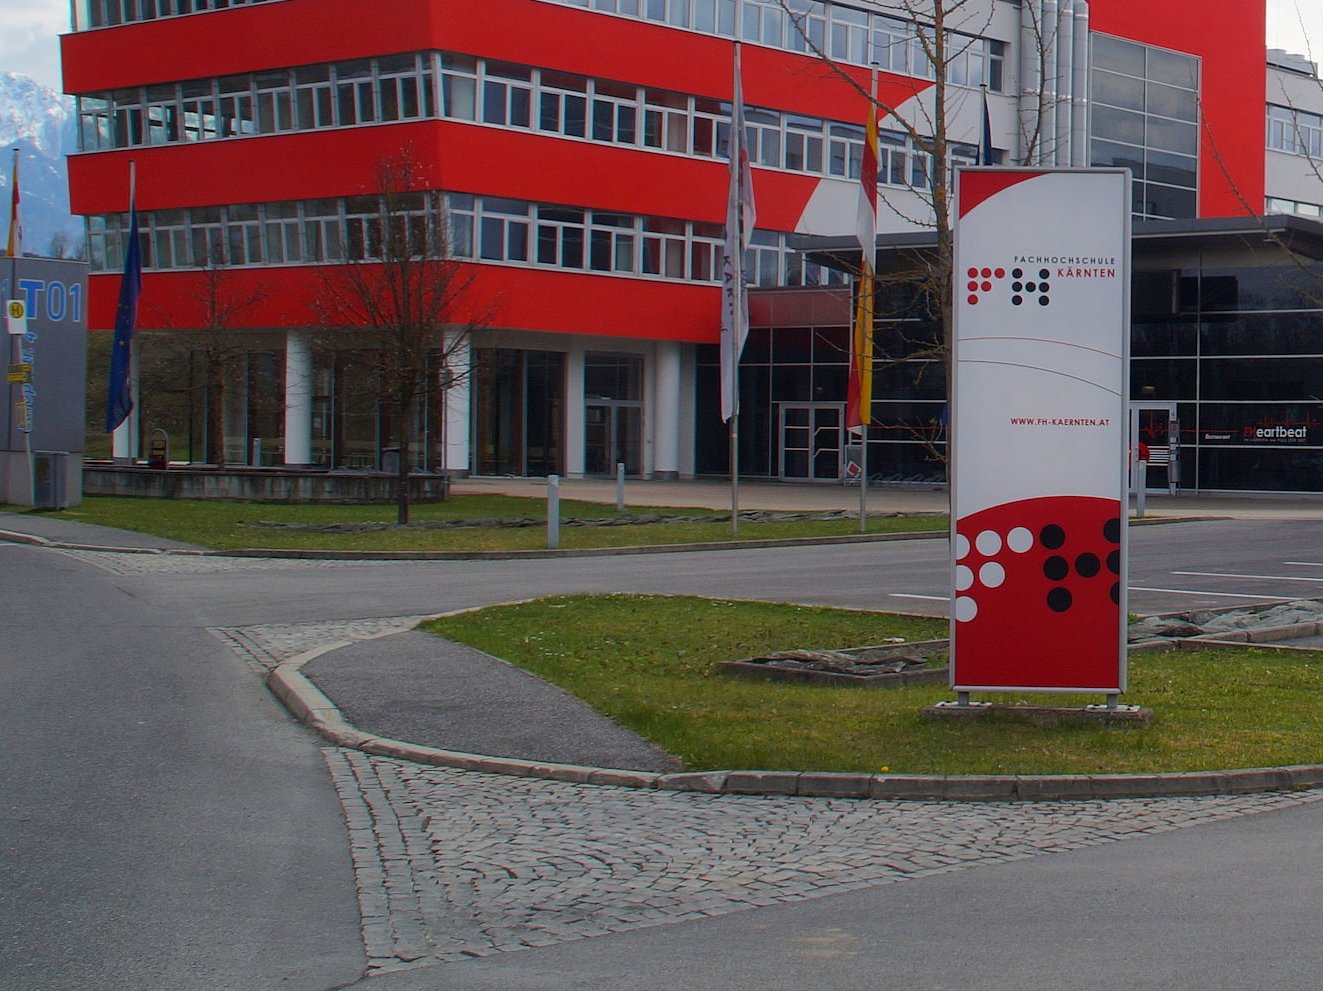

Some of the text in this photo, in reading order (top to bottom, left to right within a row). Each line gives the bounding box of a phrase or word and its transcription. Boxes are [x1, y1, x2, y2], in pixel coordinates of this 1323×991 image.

[1014, 256, 1115, 265] FACHHOCHSCHULE
[1057, 266, 1115, 278] KÄRNTEN
[1010, 418, 1110, 426] WWW.FH-KAERNTEN.AT
